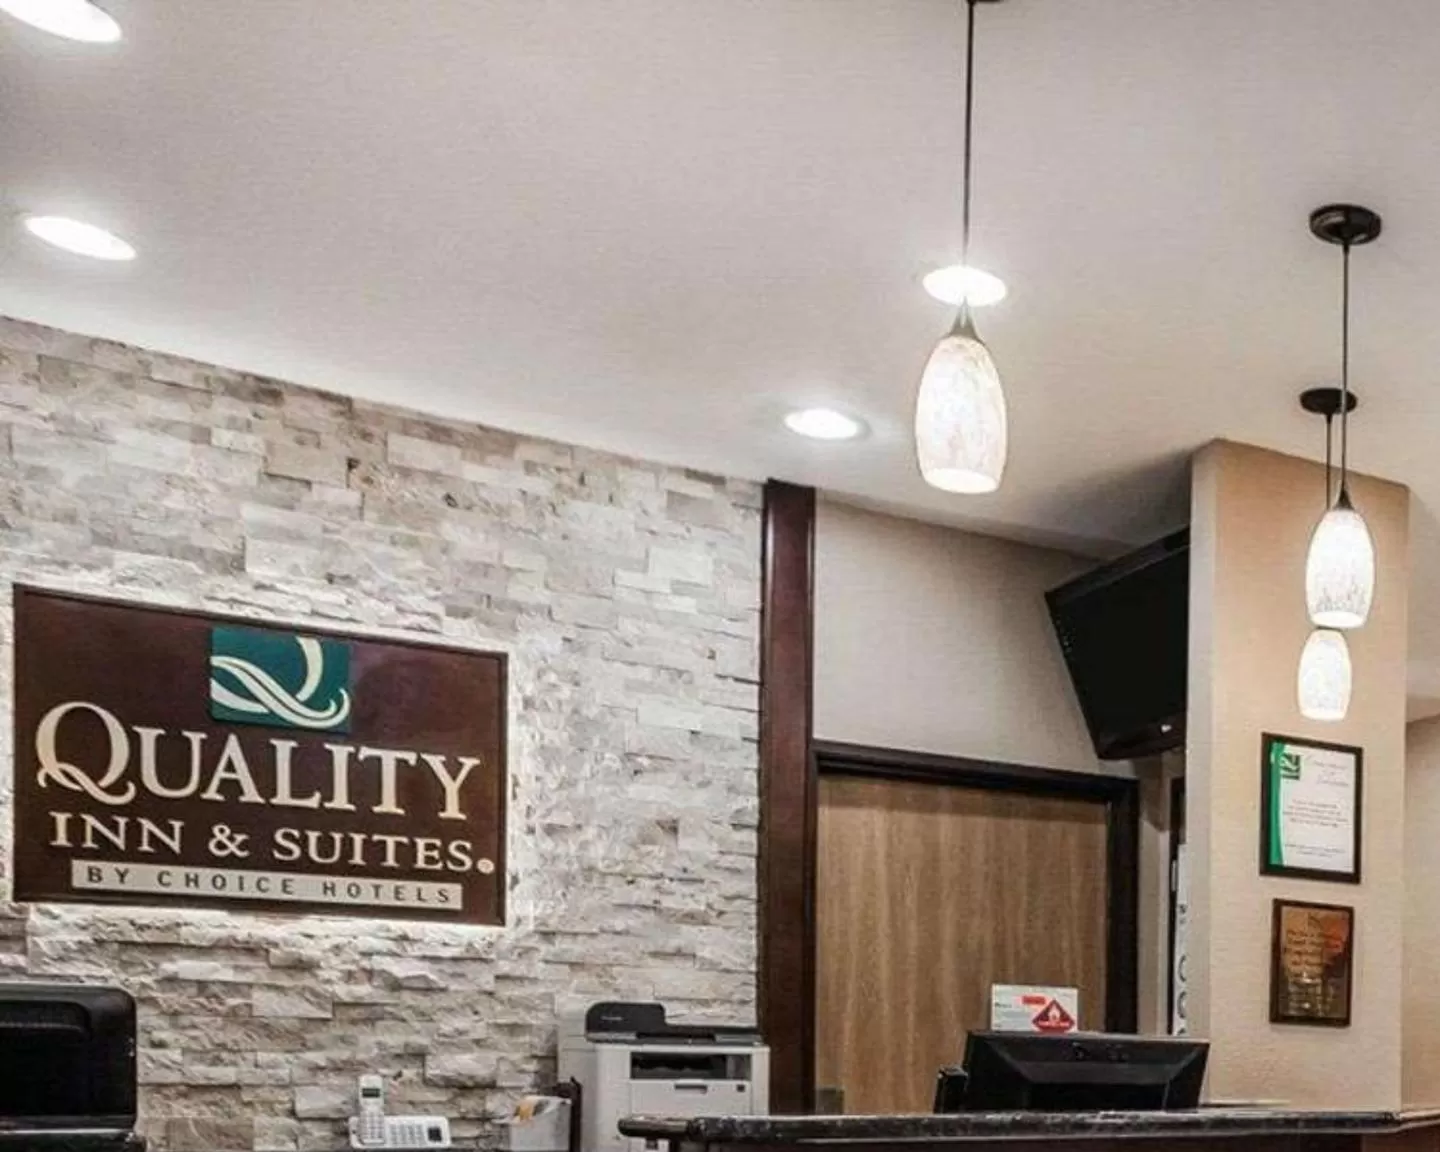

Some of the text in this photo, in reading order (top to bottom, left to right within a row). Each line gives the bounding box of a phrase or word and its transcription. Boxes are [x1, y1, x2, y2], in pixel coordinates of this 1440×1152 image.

[35, 702, 481, 820] QUALITY
[49, 811, 474, 872] INN & SUITES
[87, 865, 451, 904] BY CHOICE HOTELS
